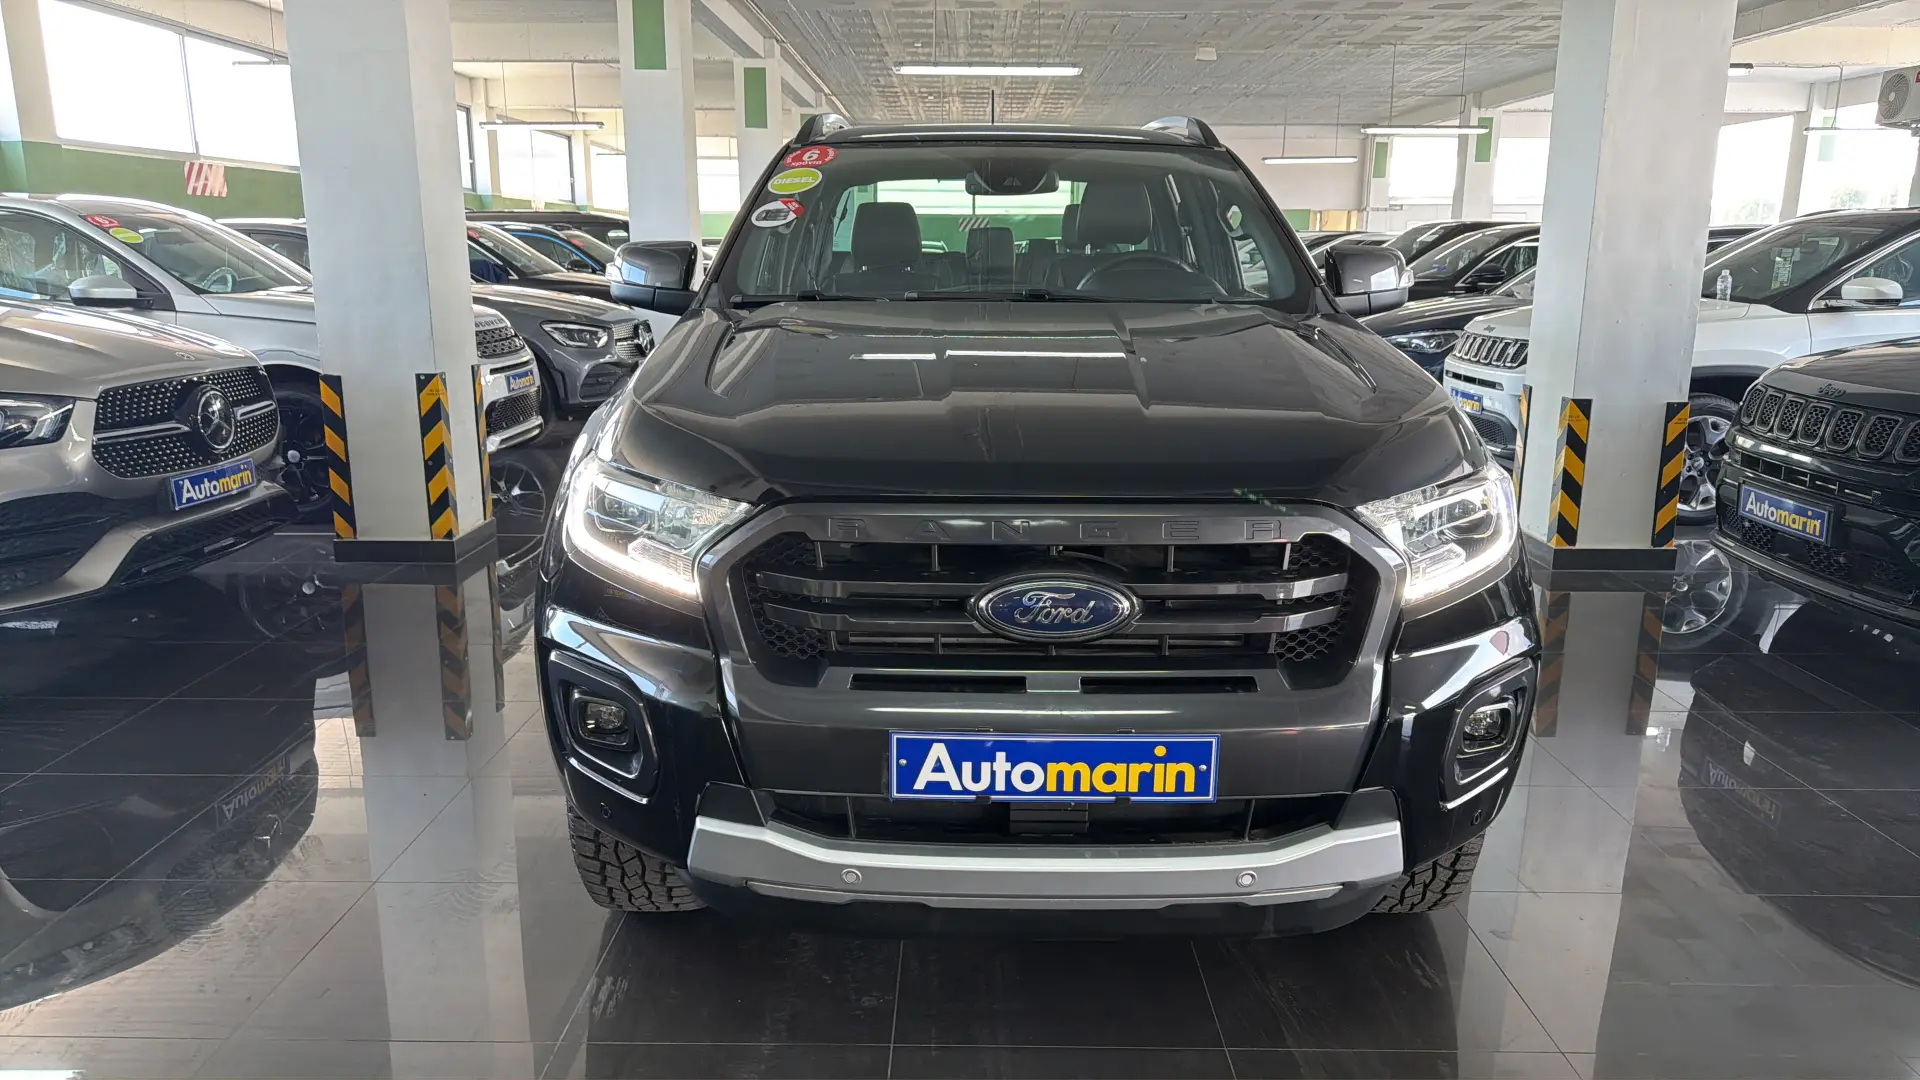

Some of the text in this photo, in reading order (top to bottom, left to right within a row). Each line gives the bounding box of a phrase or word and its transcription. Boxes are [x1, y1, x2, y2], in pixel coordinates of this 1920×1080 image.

[802, 150, 820, 161] 6
[773, 176, 816, 184] DIESEL
[182, 464, 252, 504] Automarin
[828, 517, 1283, 542] RANGER
[1745, 491, 1821, 536] Automarin
[1014, 591, 1096, 624] Ford
[912, 742, 1196, 793] Automarin
